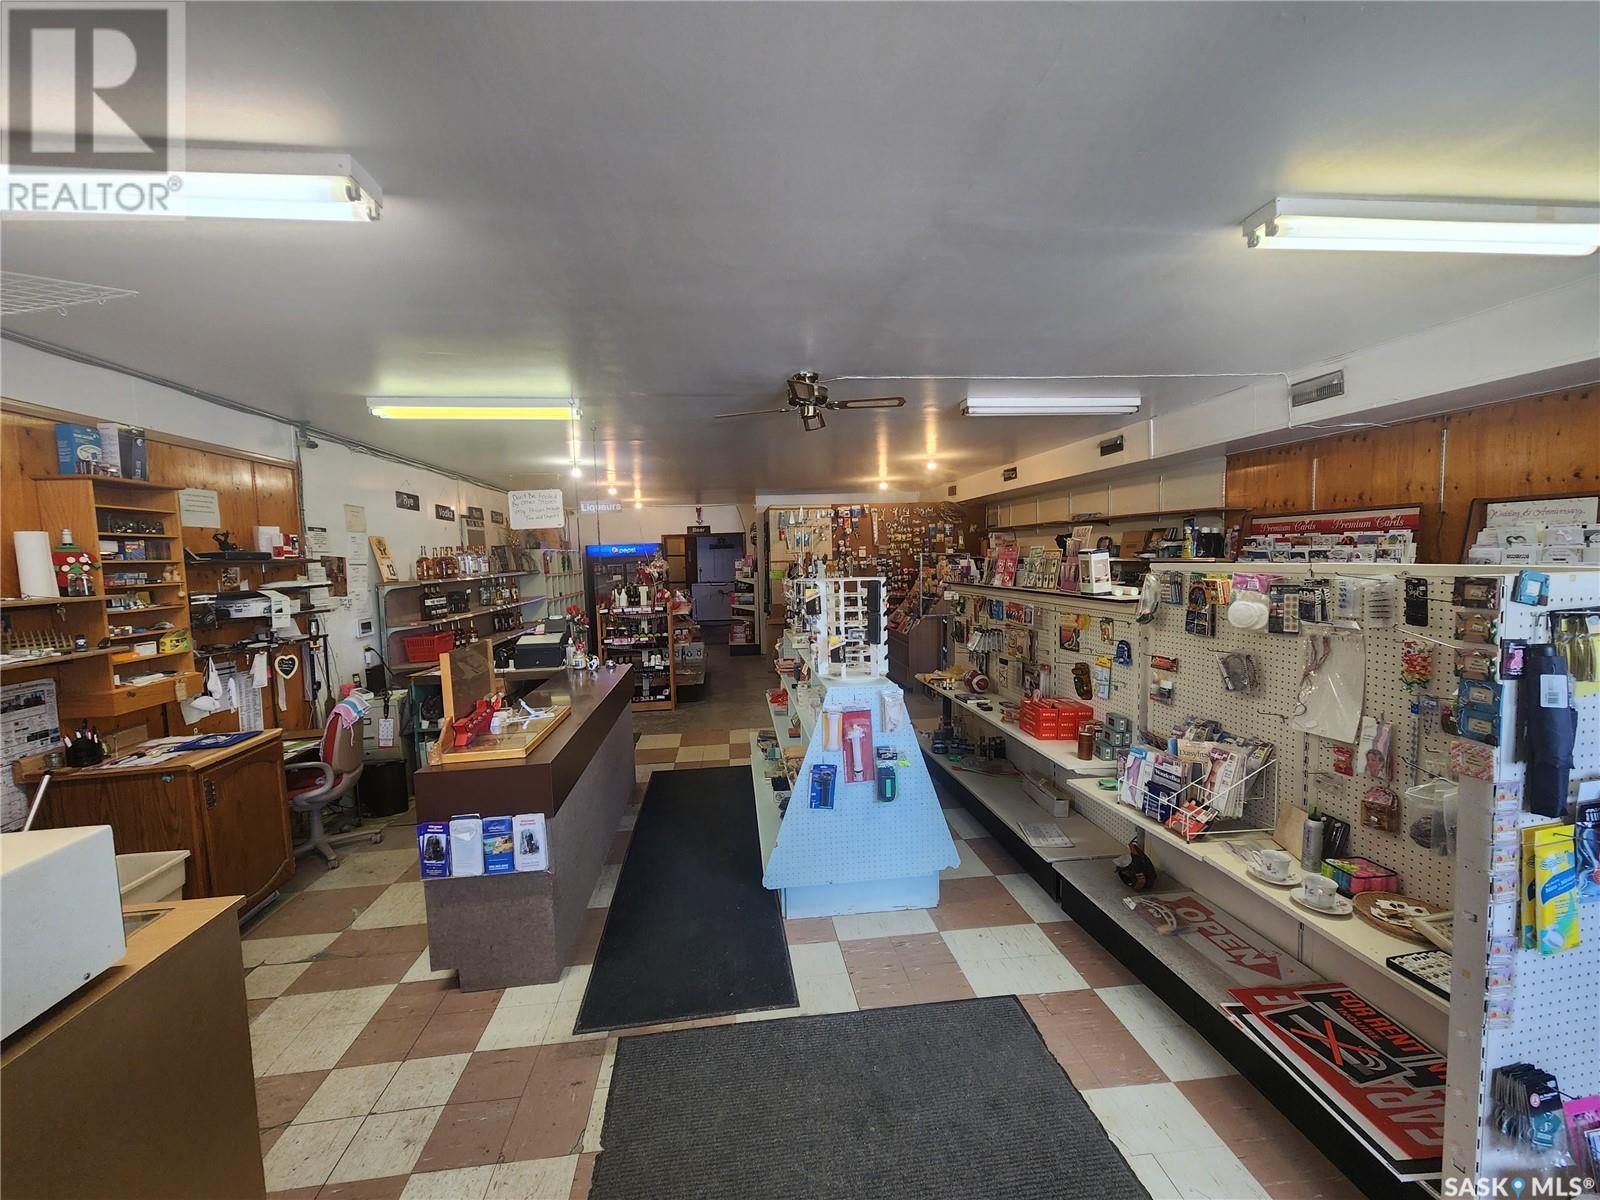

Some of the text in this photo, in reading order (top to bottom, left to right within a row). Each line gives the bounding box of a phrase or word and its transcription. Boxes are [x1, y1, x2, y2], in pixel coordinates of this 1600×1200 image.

[439, 507, 453, 519] Vodka
[581, 502, 622, 513] Liqueurs
[1523, 507, 1531, 516] &
[1261, 520, 1317, 533] Premium Cards
[1332, 514, 1404, 530] Premium Cards
[386, 563, 397, 577] 13
[1176, 907, 1272, 967] OPEN
[1330, 991, 1431, 1053] FOR RENT
[1336, 1008, 1381, 1041] INQUIRE
